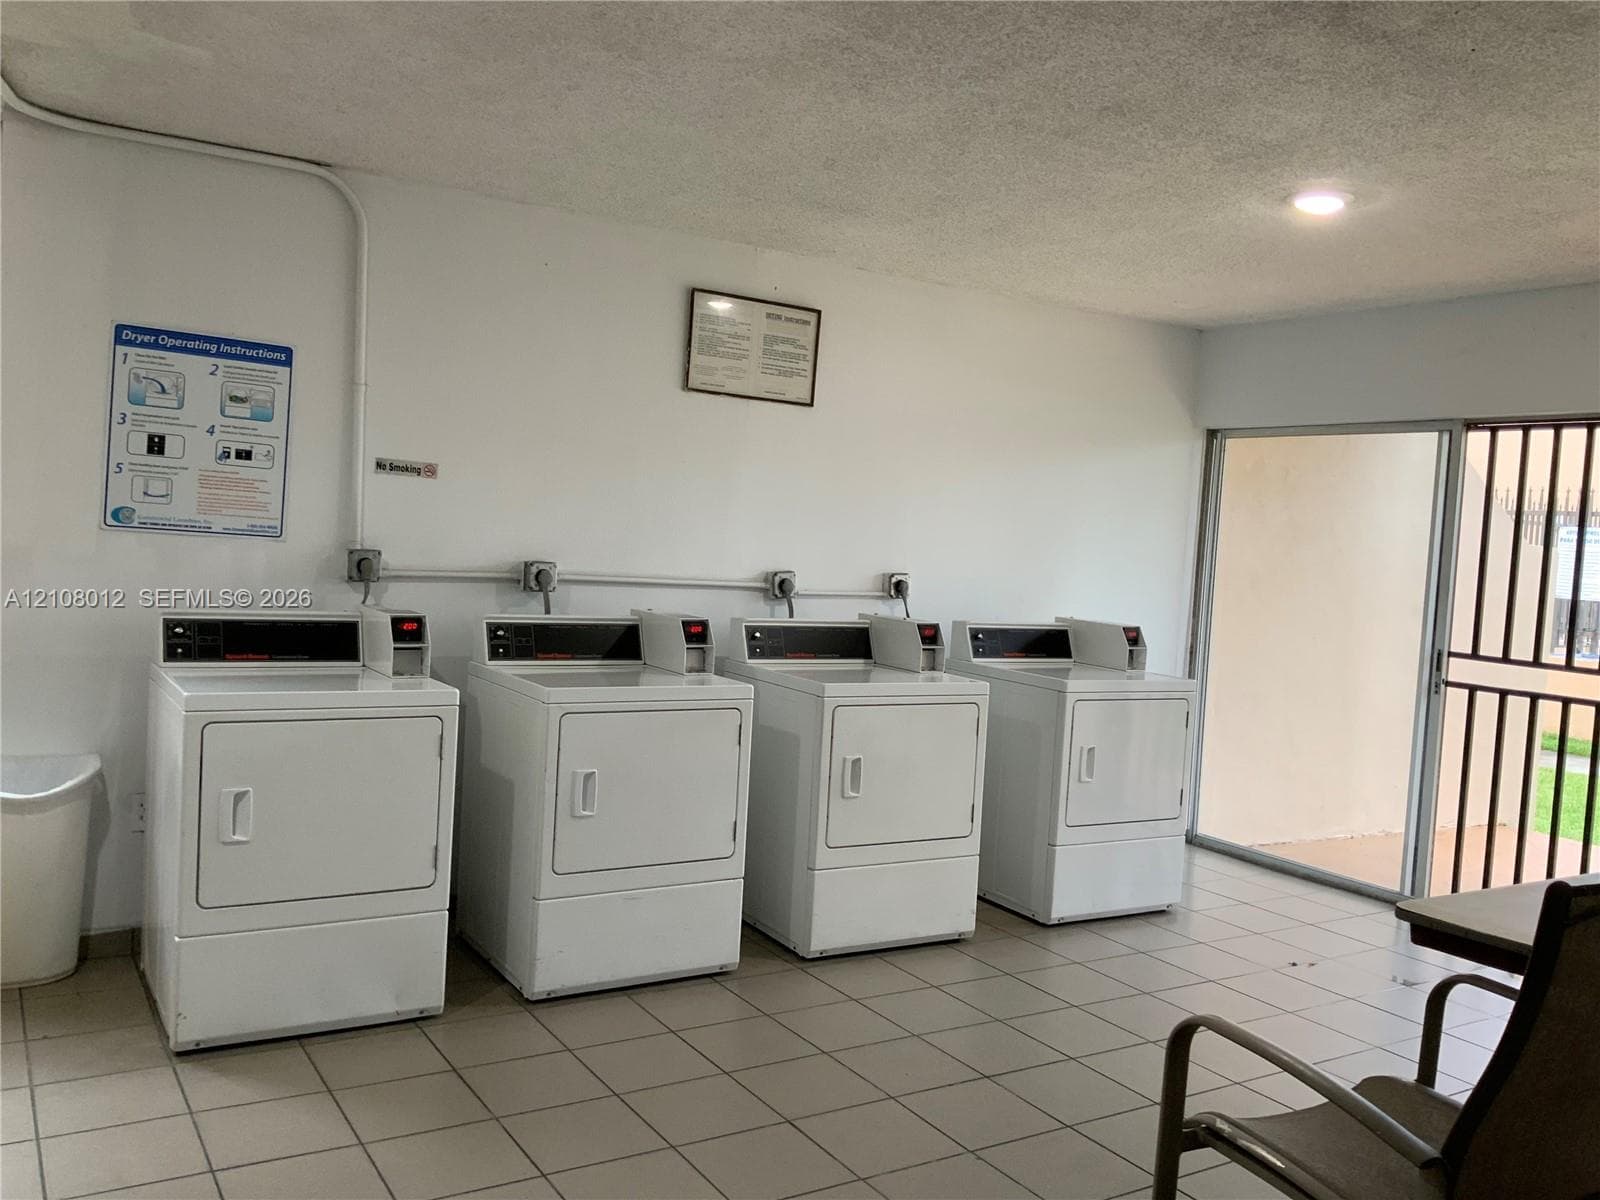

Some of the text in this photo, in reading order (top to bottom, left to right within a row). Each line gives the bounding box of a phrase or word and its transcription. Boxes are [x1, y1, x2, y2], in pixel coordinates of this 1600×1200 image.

[121, 330, 287, 361] Dryer Operating Instructions
[121, 352, 128, 365] 1
[208, 363, 219, 376] 2
[116, 412, 127, 425] 3
[206, 424, 215, 436] 4
[113, 462, 124, 474] 5
[376, 461, 421, 476] No Smoking
